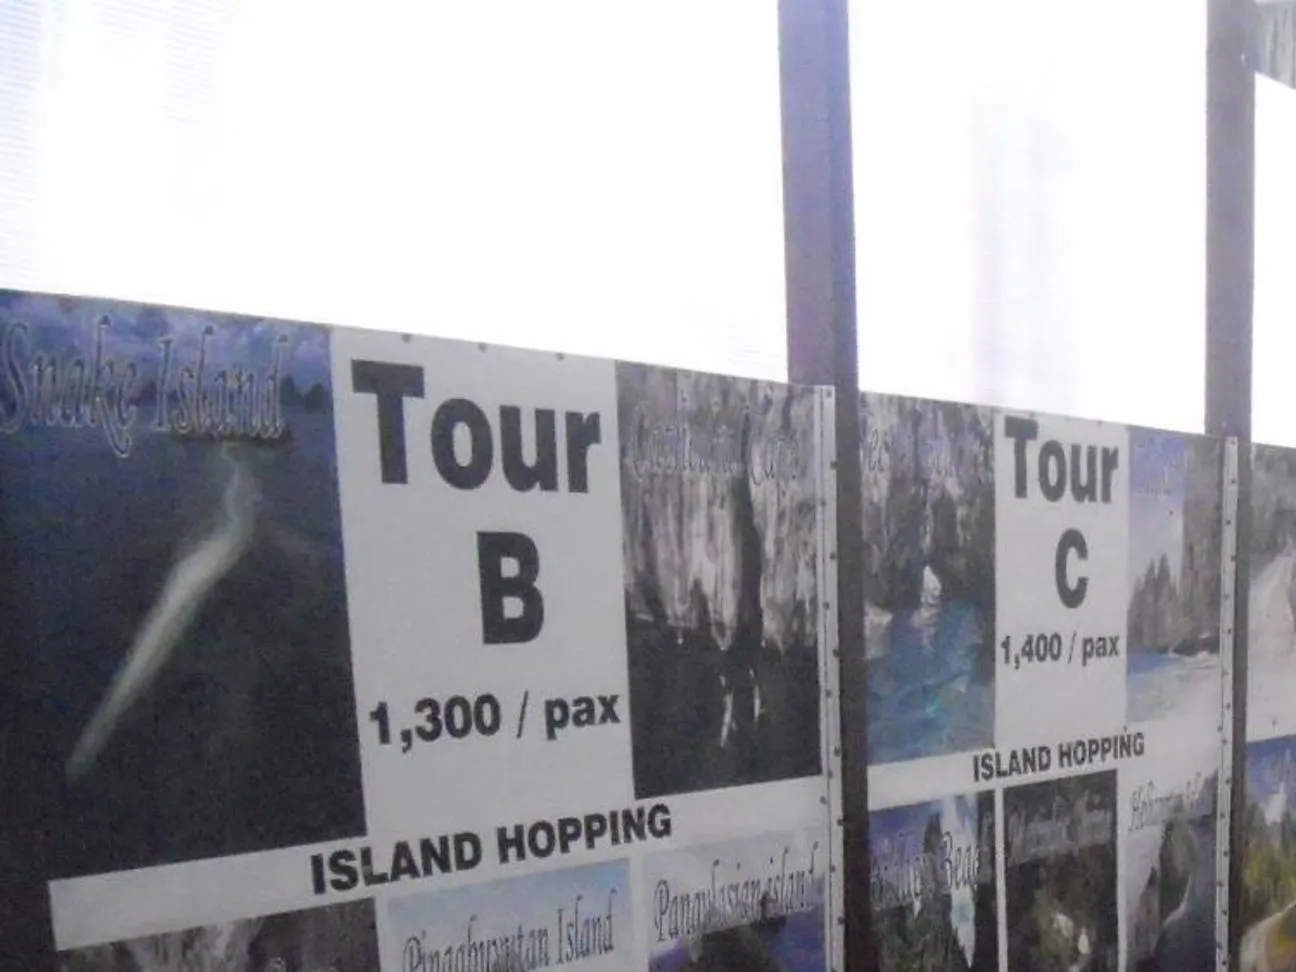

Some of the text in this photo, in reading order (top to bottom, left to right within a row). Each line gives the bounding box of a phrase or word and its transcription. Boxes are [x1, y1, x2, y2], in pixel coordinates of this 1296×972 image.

[151, 325, 289, 438] Island
[351, 358, 601, 494] Tour
[1004, 415, 1119, 503] Tour
[476, 531, 544, 645] B
[1054, 528, 1089, 609] C
[1001, 633, 1062, 671] 1,400
[1082, 634, 1120, 667] pax
[369, 693, 501, 754] 1,300
[545, 694, 621, 741] pax
[973, 731, 1146, 782] ISLAND HOPPING
[309, 803, 672, 895] ISLAND HOPPING
[556, 887, 618, 966] Island
